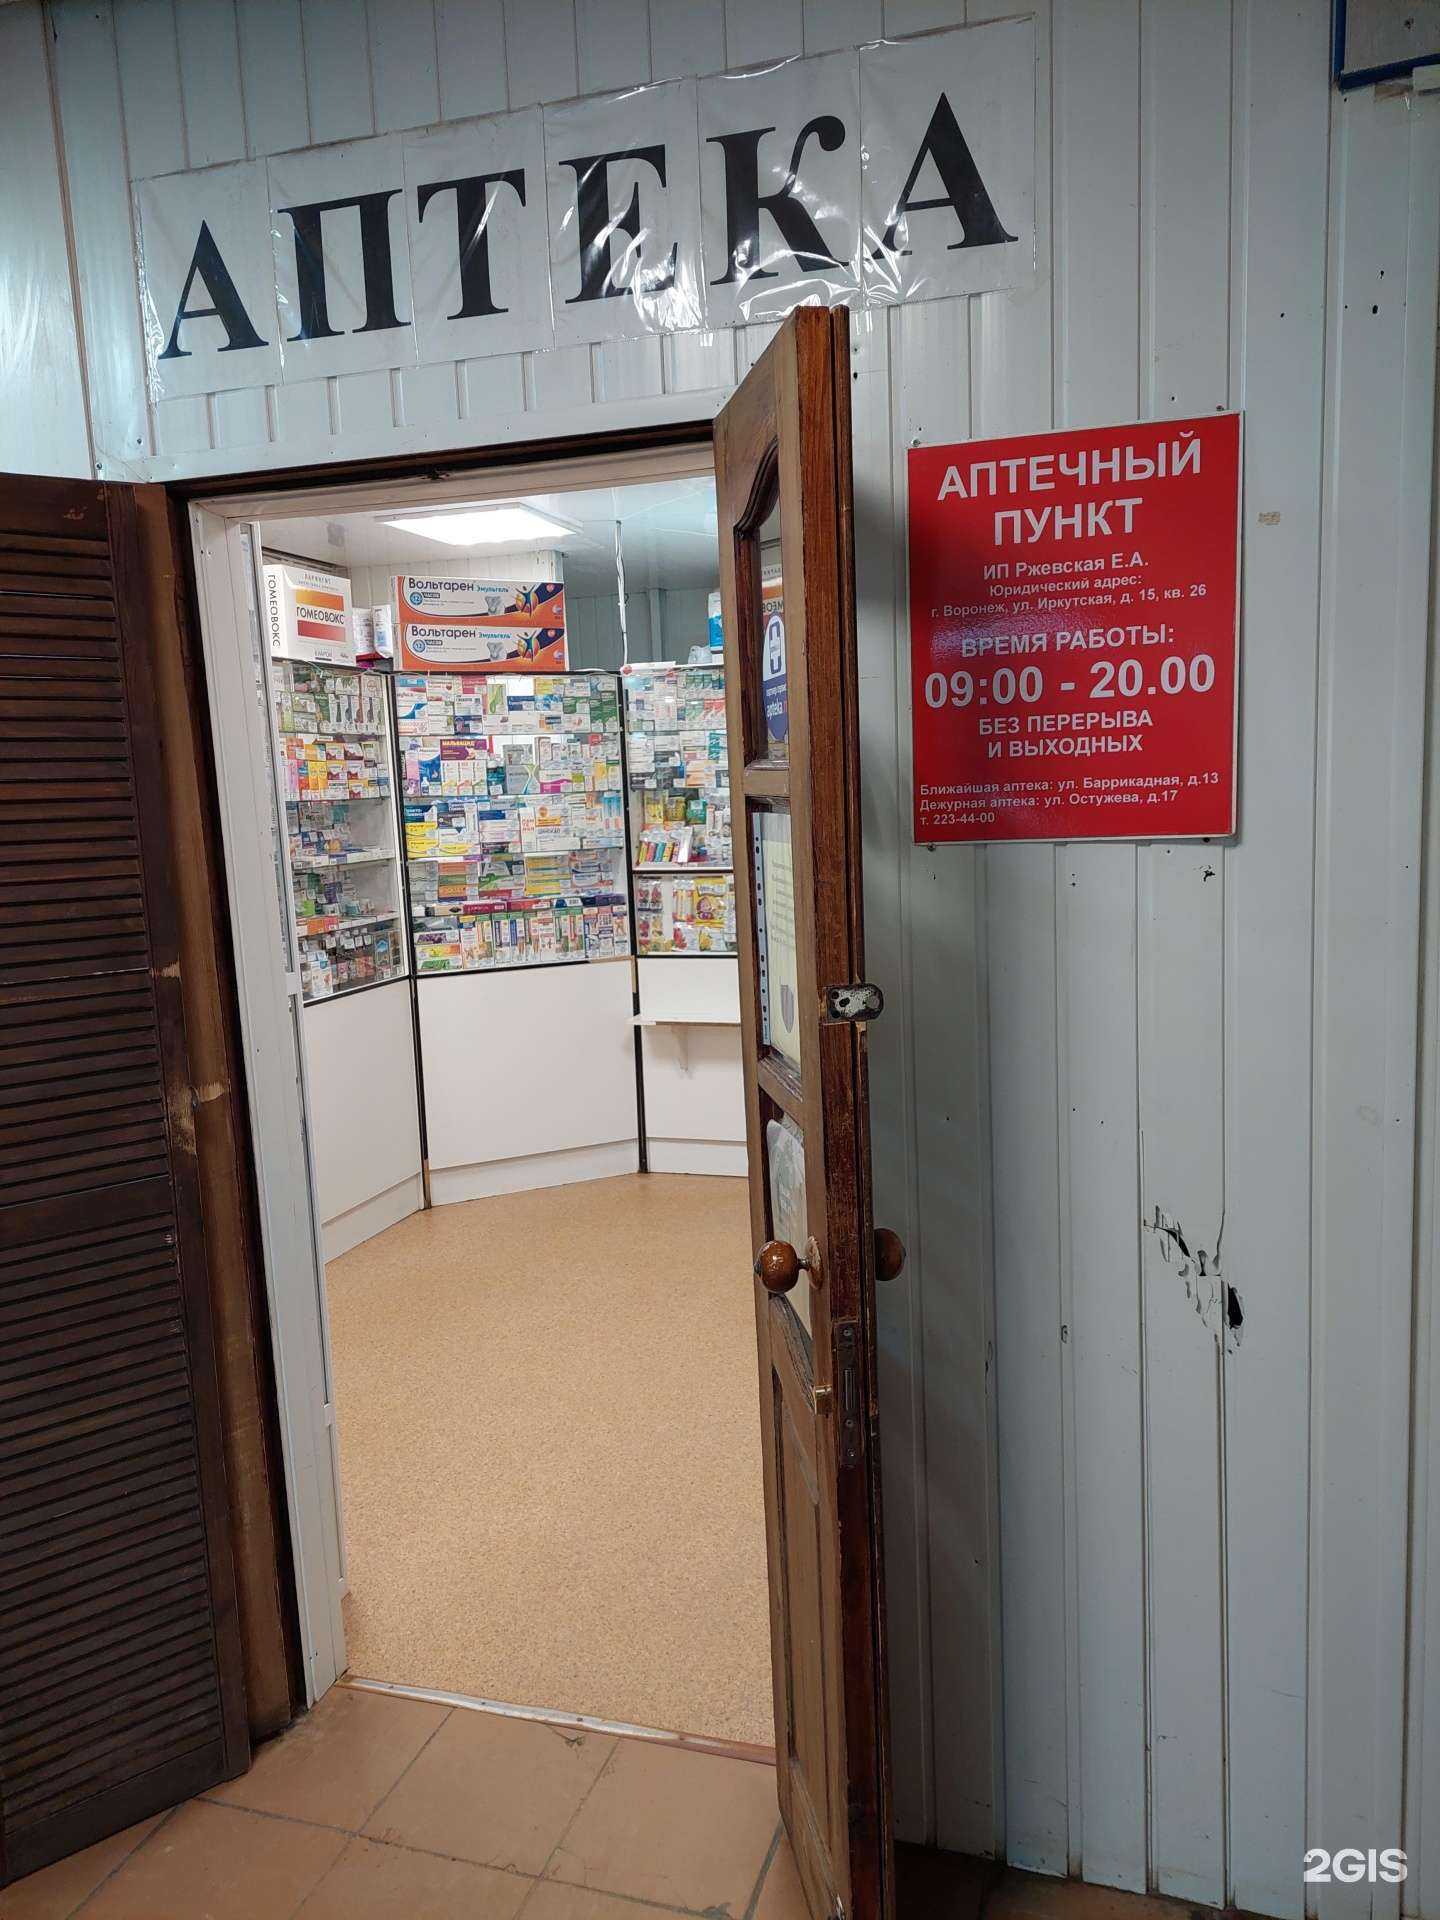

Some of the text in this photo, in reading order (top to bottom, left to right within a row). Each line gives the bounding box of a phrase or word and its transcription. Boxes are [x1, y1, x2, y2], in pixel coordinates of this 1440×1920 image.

[158, 92, 1019, 360] АПТЕКА
[937, 431, 1201, 501] АПТЕЧНЫЙ
[994, 497, 1144, 546] ПУНКТ
[983, 551, 1148, 580] ИП Ржевская Е.А.
[409, 578, 474, 593] Вольтарен
[989, 574, 1142, 597] Юридический адрес:
[268, 574, 280, 647] ГОМЕОВОКС
[943, 600, 1008, 618] Воронеж,
[1013, 598, 1034, 614] ул.
[1038, 591, 1116, 611] Иркутская,
[1120, 592, 1135, 606] д.
[1139, 588, 1159, 602] 15,
[1164, 587, 1184, 599] кв.
[1190, 584, 1207, 597] 26
[296, 607, 344, 625] ГОМЕОВОКС
[411, 626, 476, 639] Вольтарен
[962, 624, 1175, 657] ВРЕМЯ РАБОТЫ:
[925, 654, 1216, 708] 09:00 - 20.00
[979, 710, 1153, 736] БЕЗ ПЕРЕРЫВА
[988, 734, 1143, 758] И ВЫХОДНЫХ
[920, 772, 1218, 796] Ближайшая аптека: ул. Баррикадная, д.13
[920, 790, 1178, 813] Дежурная аптека: ул. Остужева, д.17
[920, 812, 995, 825] т. 223-44-00
